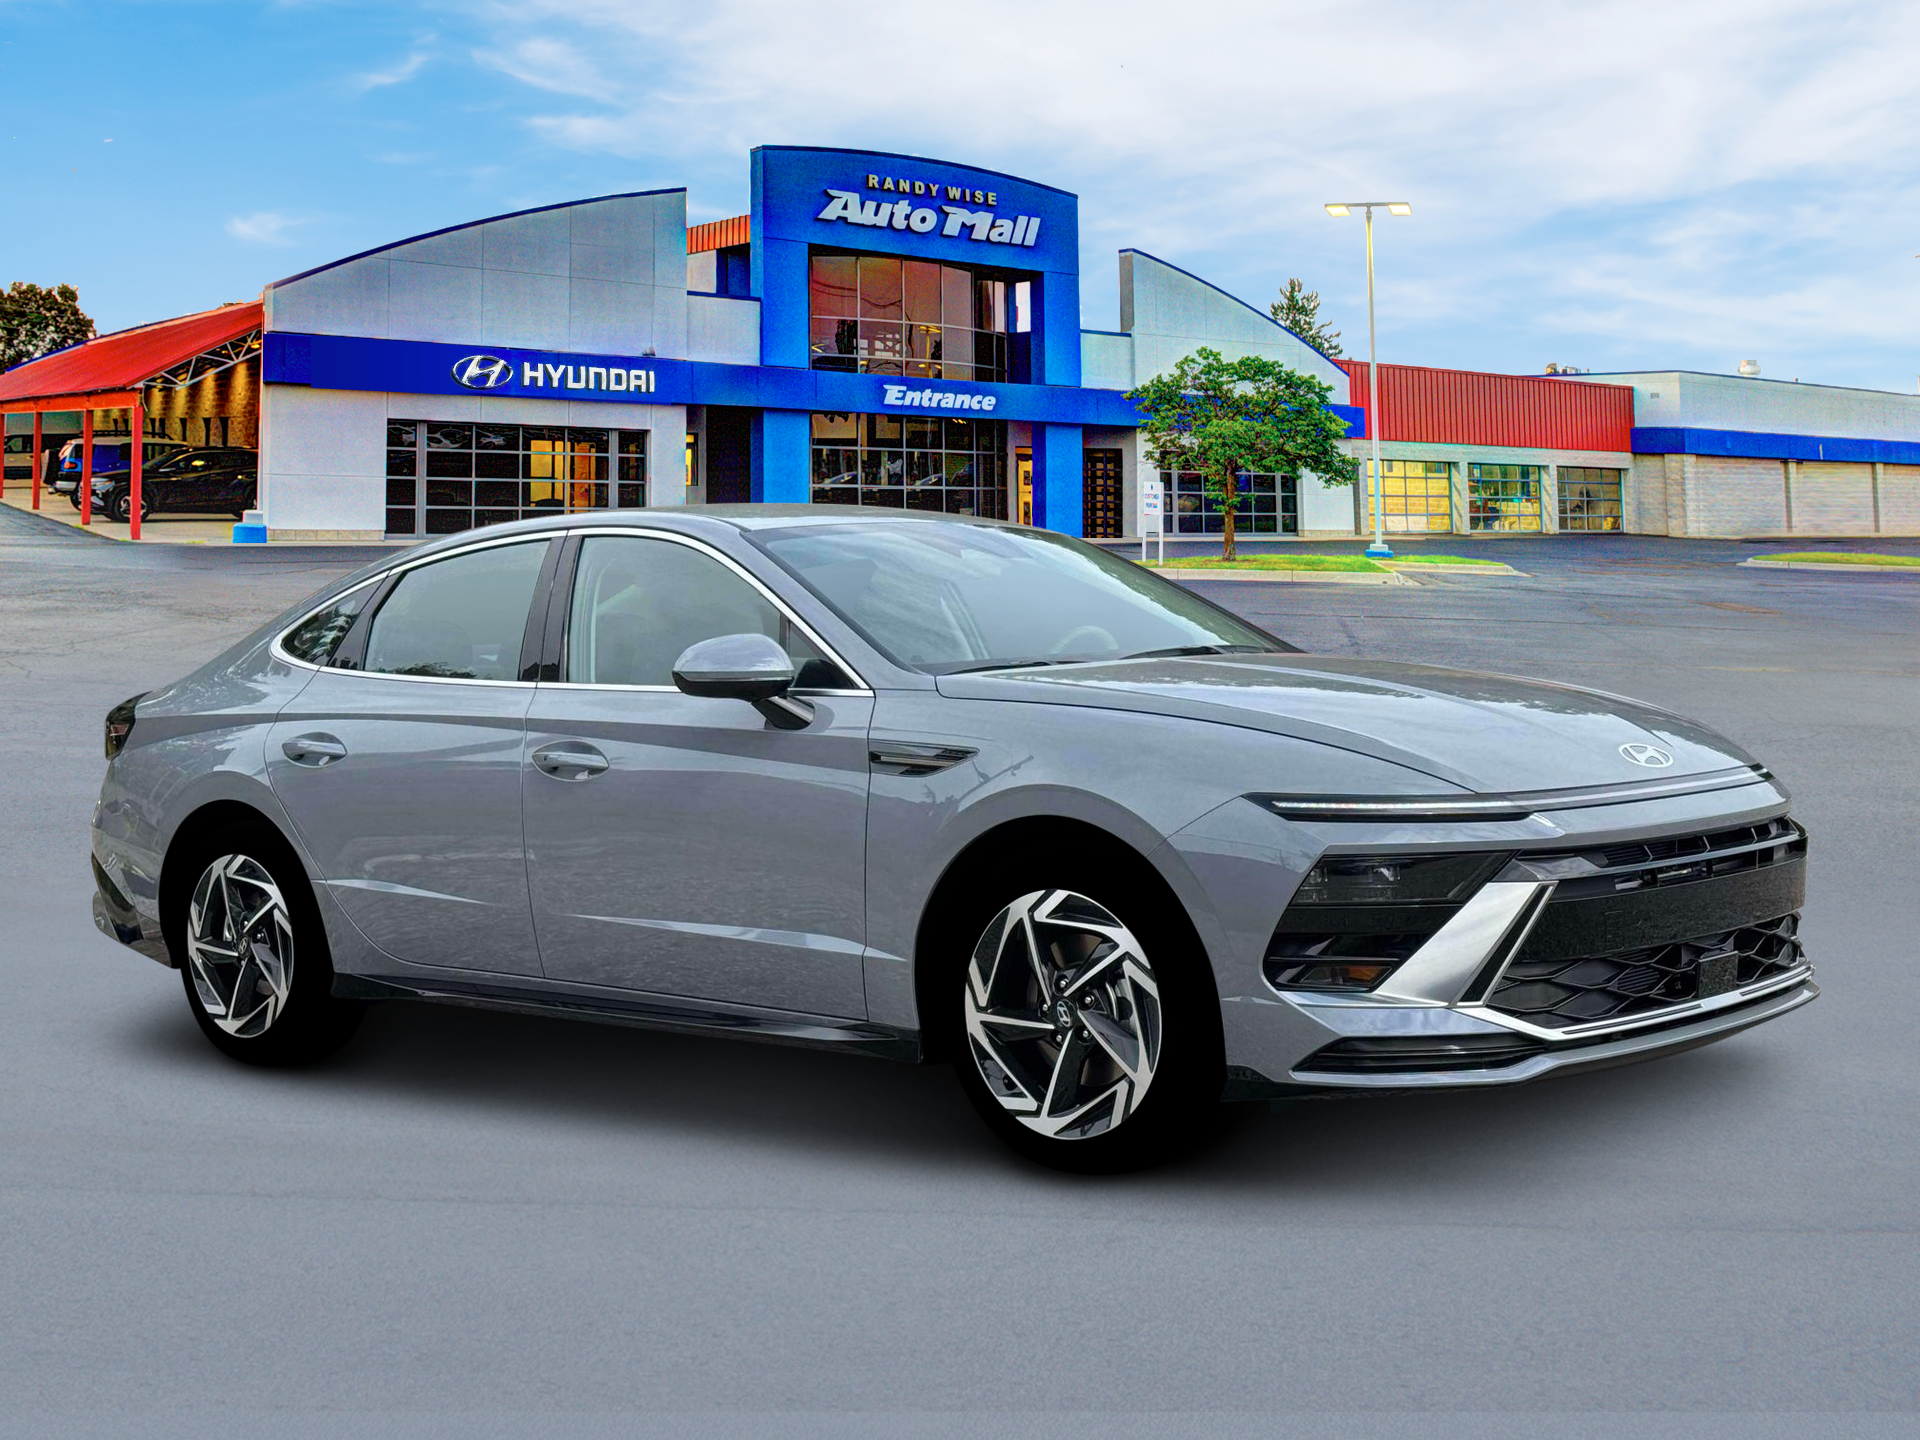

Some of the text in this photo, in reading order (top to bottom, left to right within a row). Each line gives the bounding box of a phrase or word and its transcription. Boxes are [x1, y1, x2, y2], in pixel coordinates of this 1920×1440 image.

[867, 173, 998, 206] RANDY WISE
[816, 188, 1041, 247] Auto Mall
[522, 362, 655, 393] HYUNDAI
[882, 384, 997, 411] Entrance
